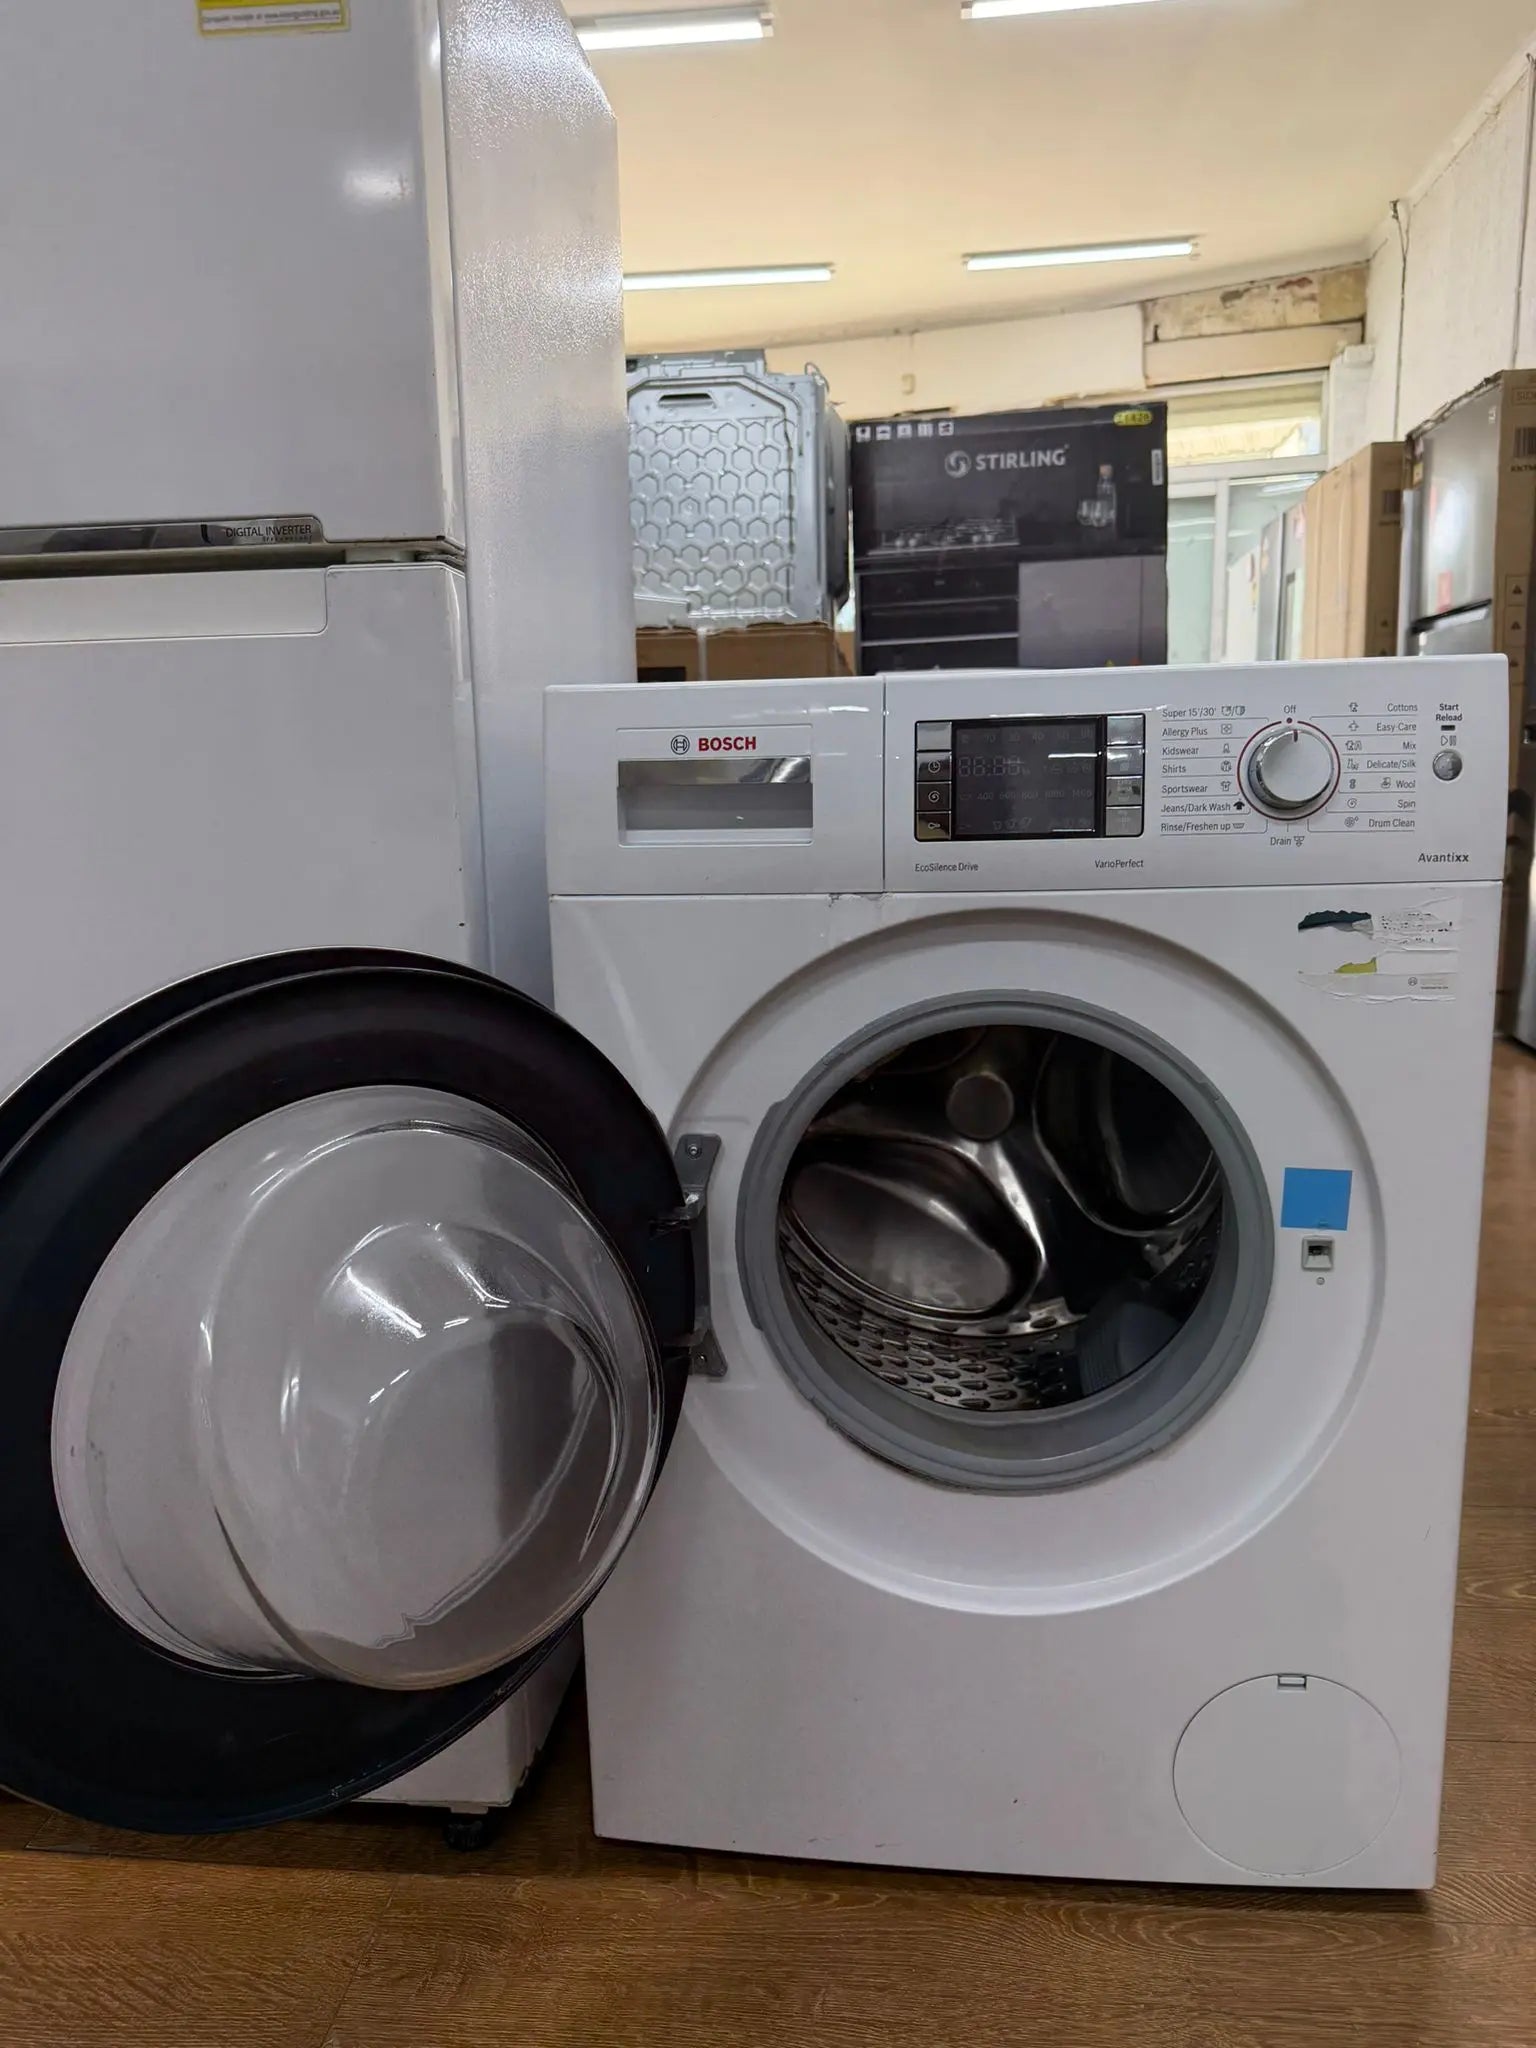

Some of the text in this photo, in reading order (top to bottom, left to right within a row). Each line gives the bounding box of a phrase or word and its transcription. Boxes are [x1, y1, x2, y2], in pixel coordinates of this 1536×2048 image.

[975, 448, 1066, 471] STIRLING
[226, 524, 312, 538] DIGITAL INVERTER
[1284, 704, 1296, 714] Off
[1387, 703, 1418, 712] Cottons
[1439, 703, 1459, 711] Start
[1162, 707, 1217, 718] Super 15'/30'
[1435, 713, 1463, 721] Reload
[1162, 727, 1208, 737] Allergy Plus
[1376, 722, 1417, 732] Easy Care
[698, 736, 757, 751] BOSCH
[1402, 741, 1416, 750] Mix
[1162, 747, 1199, 756] Kidswear
[1162, 764, 1186, 774] Shirts
[1366, 759, 1416, 769] Delicate/Silk
[1395, 779, 1416, 788] Wool
[1161, 784, 1208, 794] Sportswear
[1161, 802, 1231, 813] Jeans/Dark Wash
[1397, 799, 1416, 809] Spin
[1160, 822, 1231, 832] Rinse/Freshen up
[1368, 818, 1416, 828] Drum Clean
[1270, 836, 1292, 846] Drain
[1417, 852, 1470, 863] Avantixx
[915, 862, 979, 872] EcoSilence Drive
[1095, 859, 1144, 869] VarioPerfect
